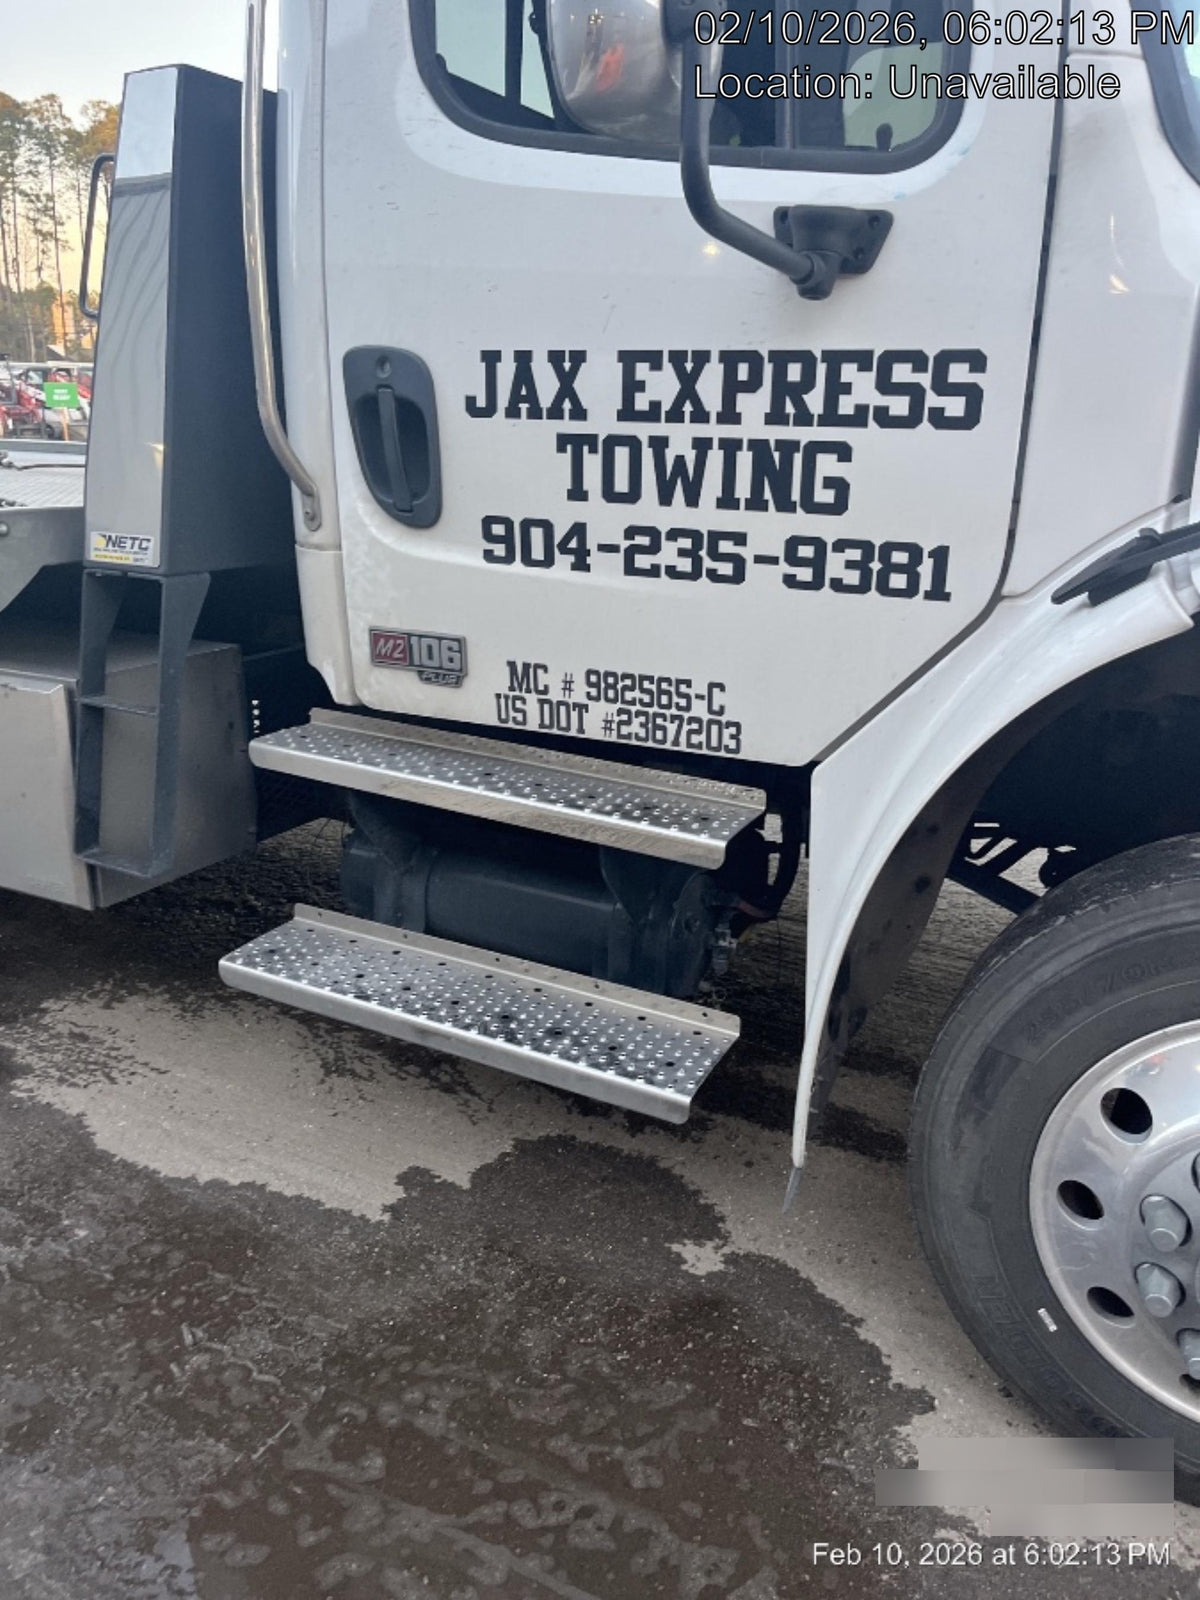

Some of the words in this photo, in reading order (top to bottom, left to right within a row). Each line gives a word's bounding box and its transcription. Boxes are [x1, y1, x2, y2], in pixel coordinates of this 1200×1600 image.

[465, 350, 588, 422] JAX
[616, 348, 988, 431] EXPRESS
[556, 433, 853, 516] TOWING
[481, 515, 952, 602] 904-235-9381
[376, 637, 405, 659] M2
[410, 636, 462, 671] 106
[506, 660, 550, 696] MC
[561, 672, 575, 699] #
[584, 668, 727, 717] 982565-C
[495, 693, 528, 726] US
[537, 698, 589, 735] DOT
